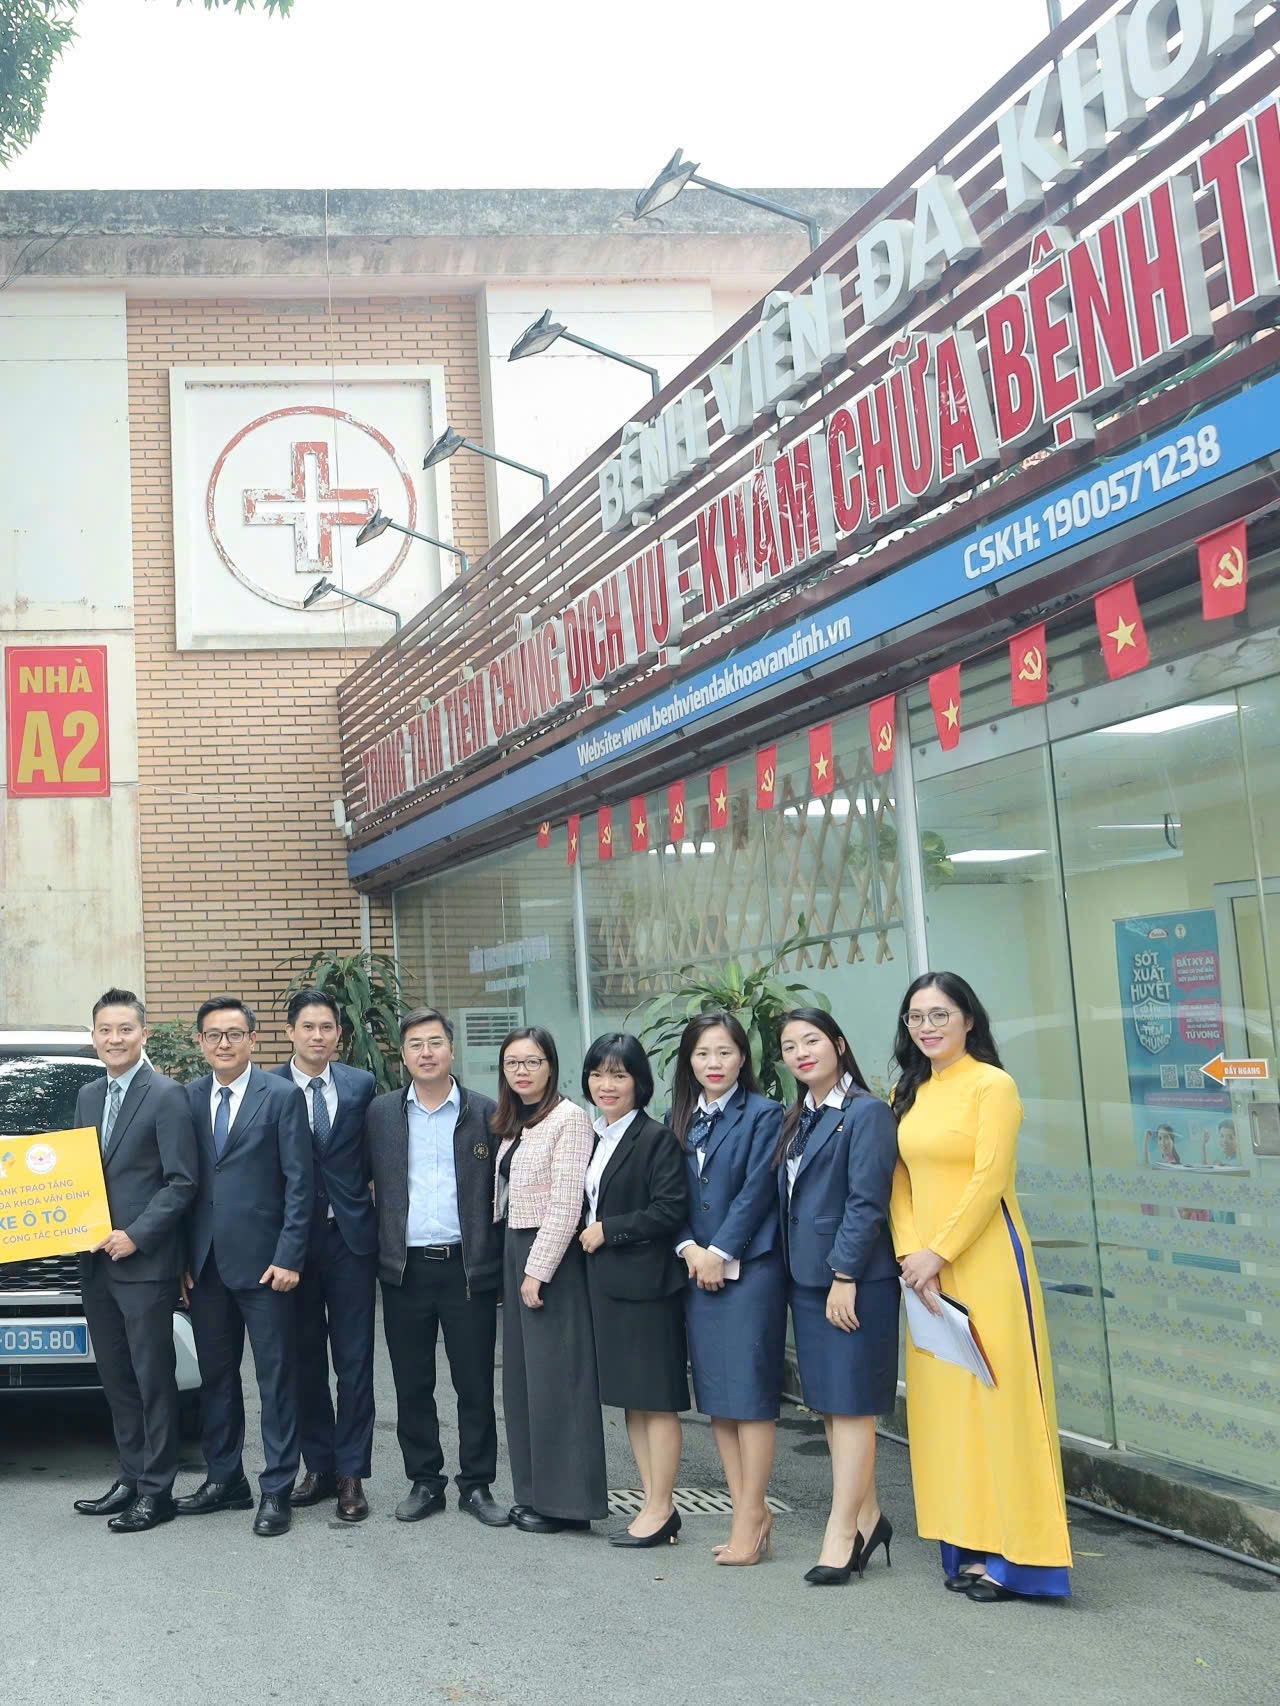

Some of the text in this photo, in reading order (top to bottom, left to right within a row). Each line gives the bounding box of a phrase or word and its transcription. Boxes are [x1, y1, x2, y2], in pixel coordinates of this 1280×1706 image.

[598, 421, 710, 532] BỆNH
[709, 290, 846, 435] VIỆN
[854, 173, 981, 327] ĐA
[361, 729, 412, 813] TRUNG
[408, 697, 449, 787] TÂM
[443, 667, 490, 771] TIÊM
[489, 613, 566, 738] CHỦNG
[562, 574, 626, 708] DỊCH
[625, 540, 674, 667] VỤ
[696, 439, 826, 616] KHÁM
[826, 332, 983, 536] CHỮA
[983, 226, 1190, 448] BỆNH
[963, 424, 1221, 580] CSKH: 1900571238
[19, 657, 93, 694] NHÀ
[17, 710, 101, 783] A2
[13, 1198, 41, 1208] KHOA
[19, 1183, 47, 1194] TRAO
[22, 1210, 37, 1227] Ô
[41, 1205, 67, 1225] TÔ
[53, 1224, 89, 1237] CHUNG
